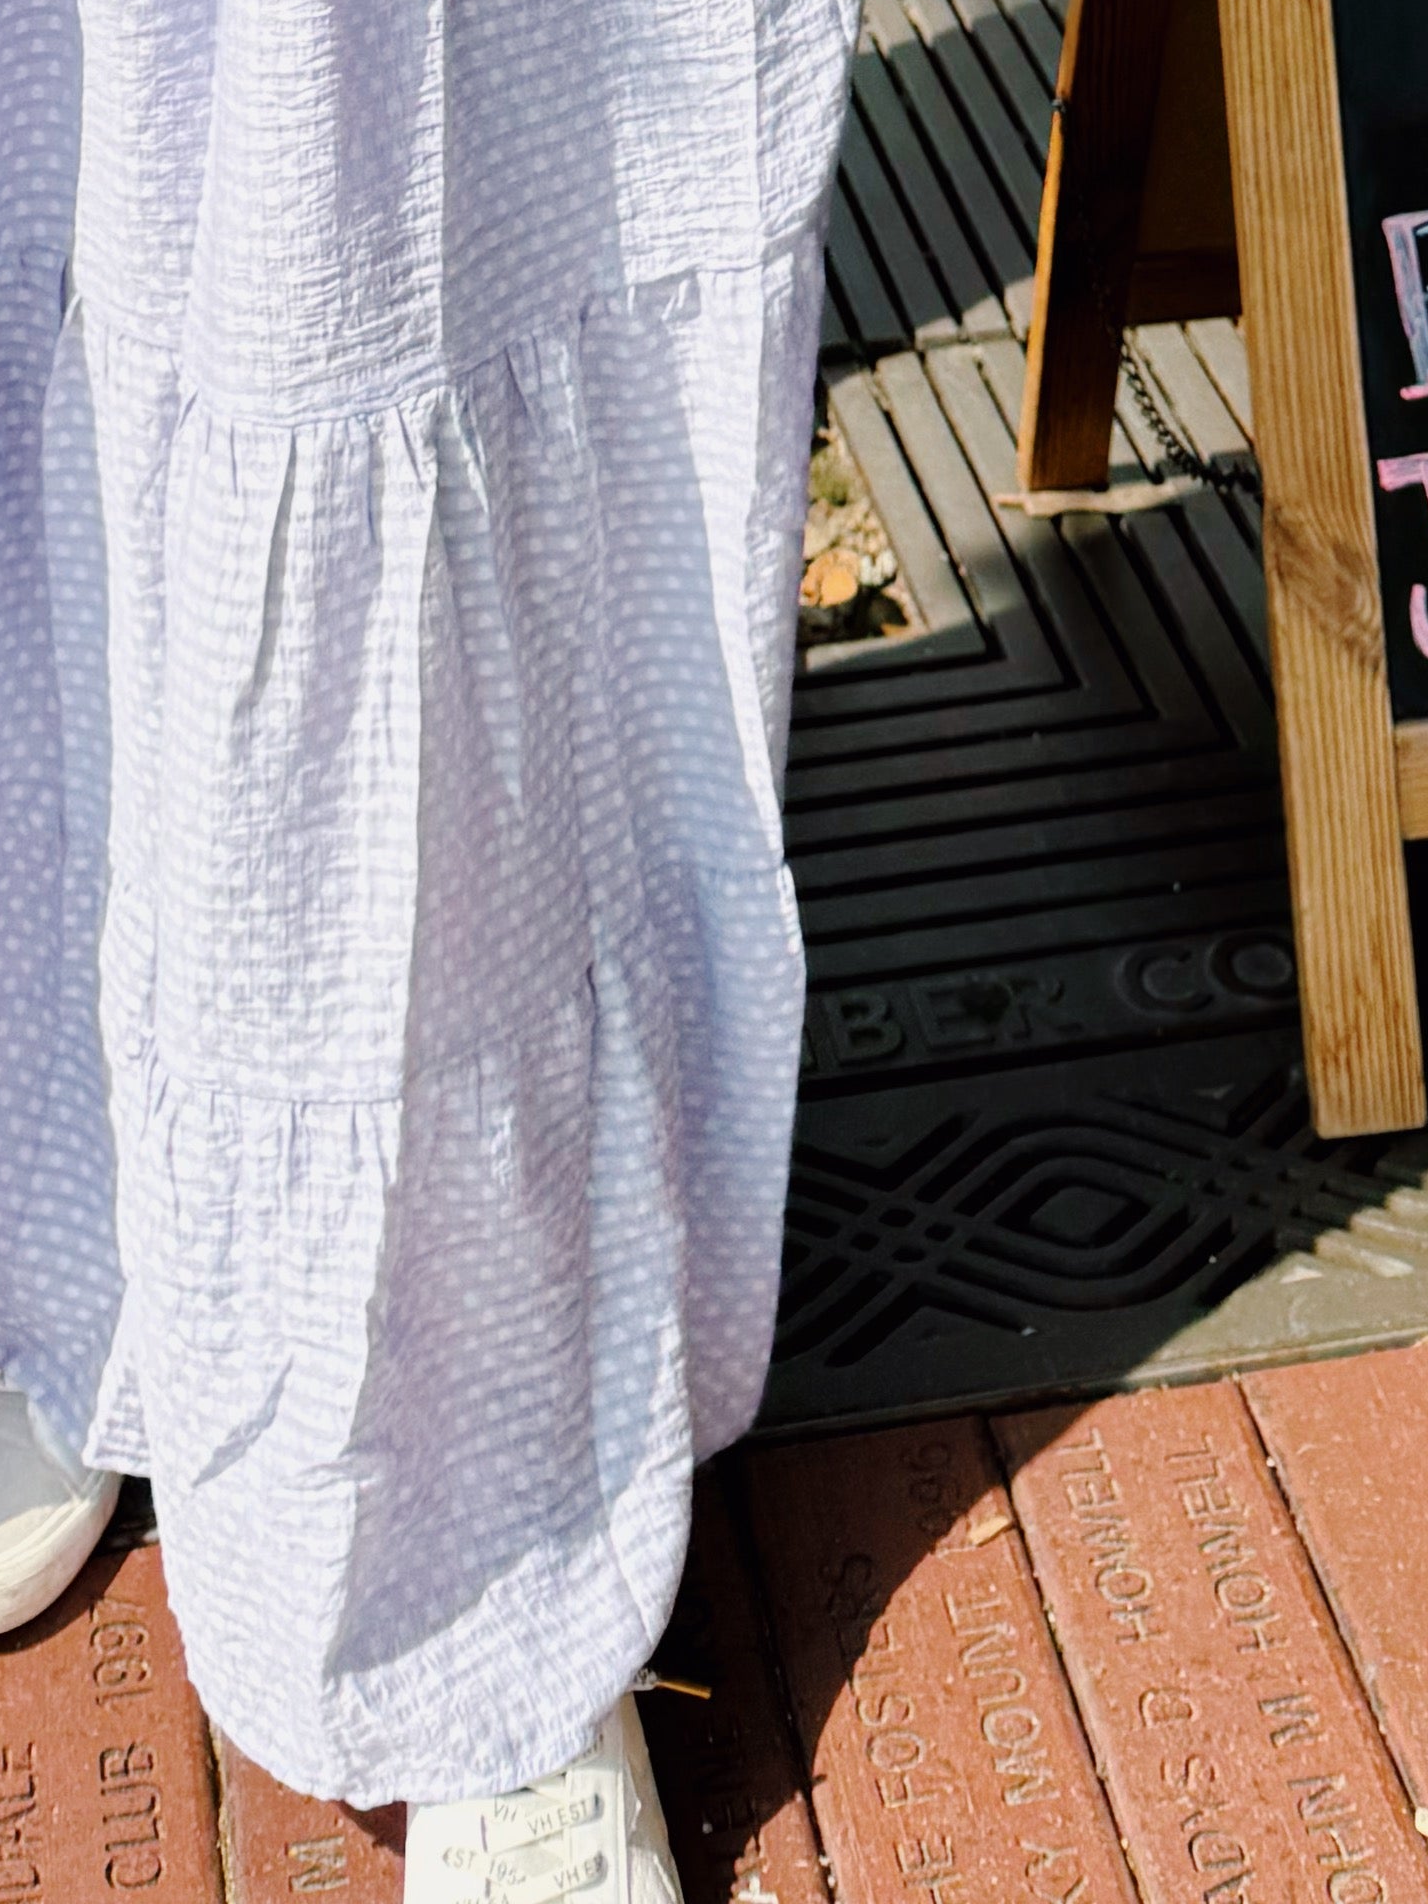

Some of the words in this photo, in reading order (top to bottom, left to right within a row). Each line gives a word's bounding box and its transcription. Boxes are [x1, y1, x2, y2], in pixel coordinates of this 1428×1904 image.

[1053, 1426, 1165, 1646] HOWELL
[1166, 1432, 1288, 1654] HOWELL
[92, 1594, 154, 1707] 1997
[822, 1551, 953, 1809] FOSTERS
[945, 1590, 1060, 1807] MOUNT
[98, 1740, 168, 1892] CLUB
